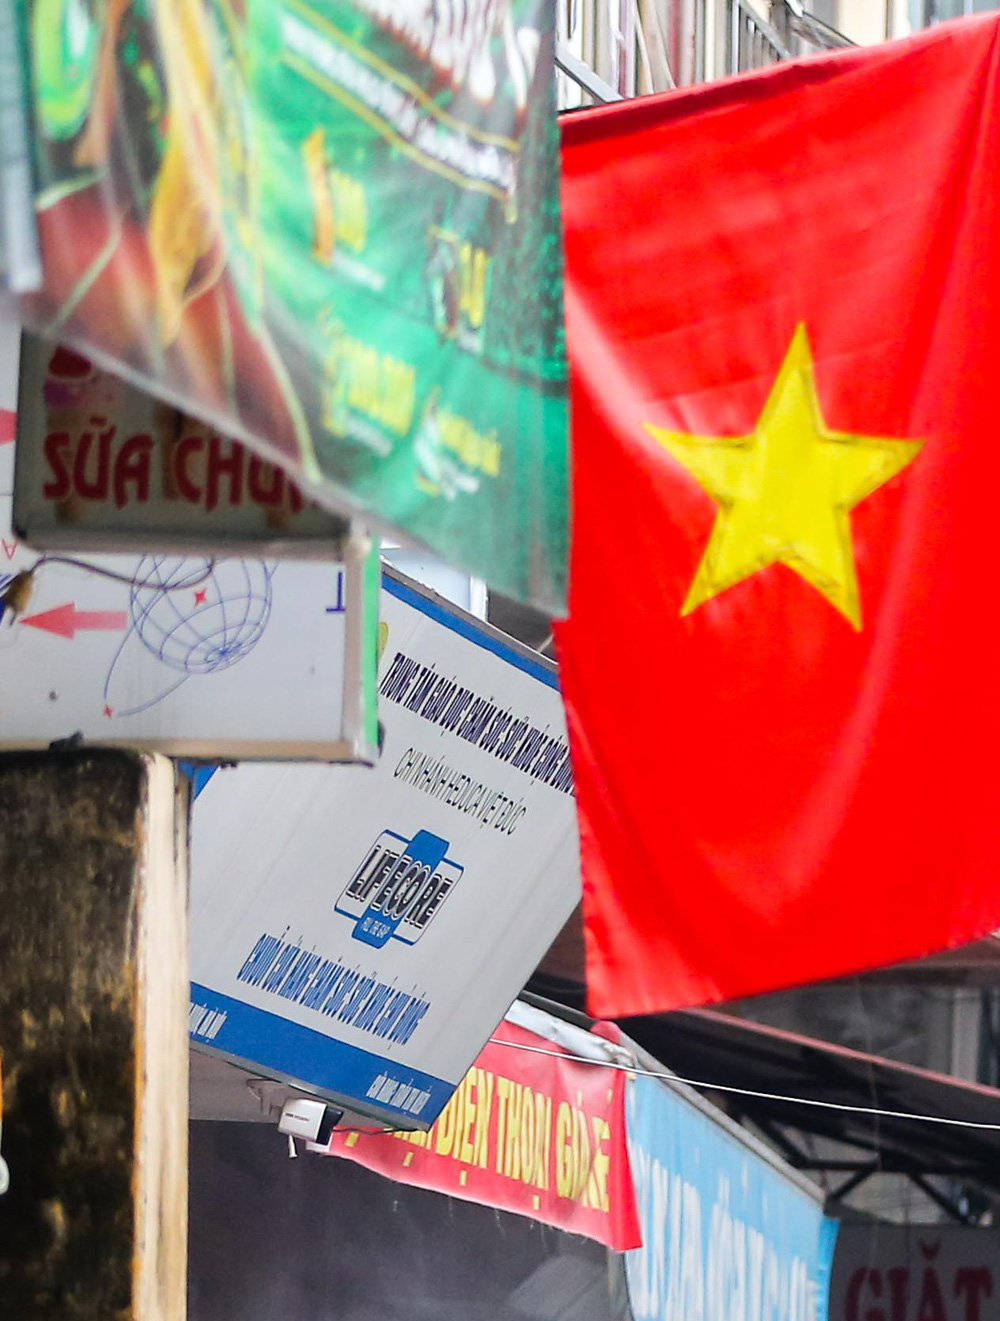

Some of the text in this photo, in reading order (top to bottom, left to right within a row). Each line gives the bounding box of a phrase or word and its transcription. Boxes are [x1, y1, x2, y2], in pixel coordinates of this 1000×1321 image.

[379, 652, 420, 704] TRUNG
[403, 663, 439, 714] TÂM
[420, 675, 458, 724] GIÁO
[439, 687, 475, 738] DỤC
[456, 696, 498, 745] CHĂM
[479, 706, 514, 754] SÓC
[495, 716, 530, 762] SỨC
[394, 748, 419, 782] CHI
[410, 754, 455, 799] NHÁNH
[473, 790, 509, 829] VIỆT
[494, 796, 527, 835] ĐỨC
[346, 844, 453, 929] LIFECORE
[496, 1075, 553, 1211] THOẠI
